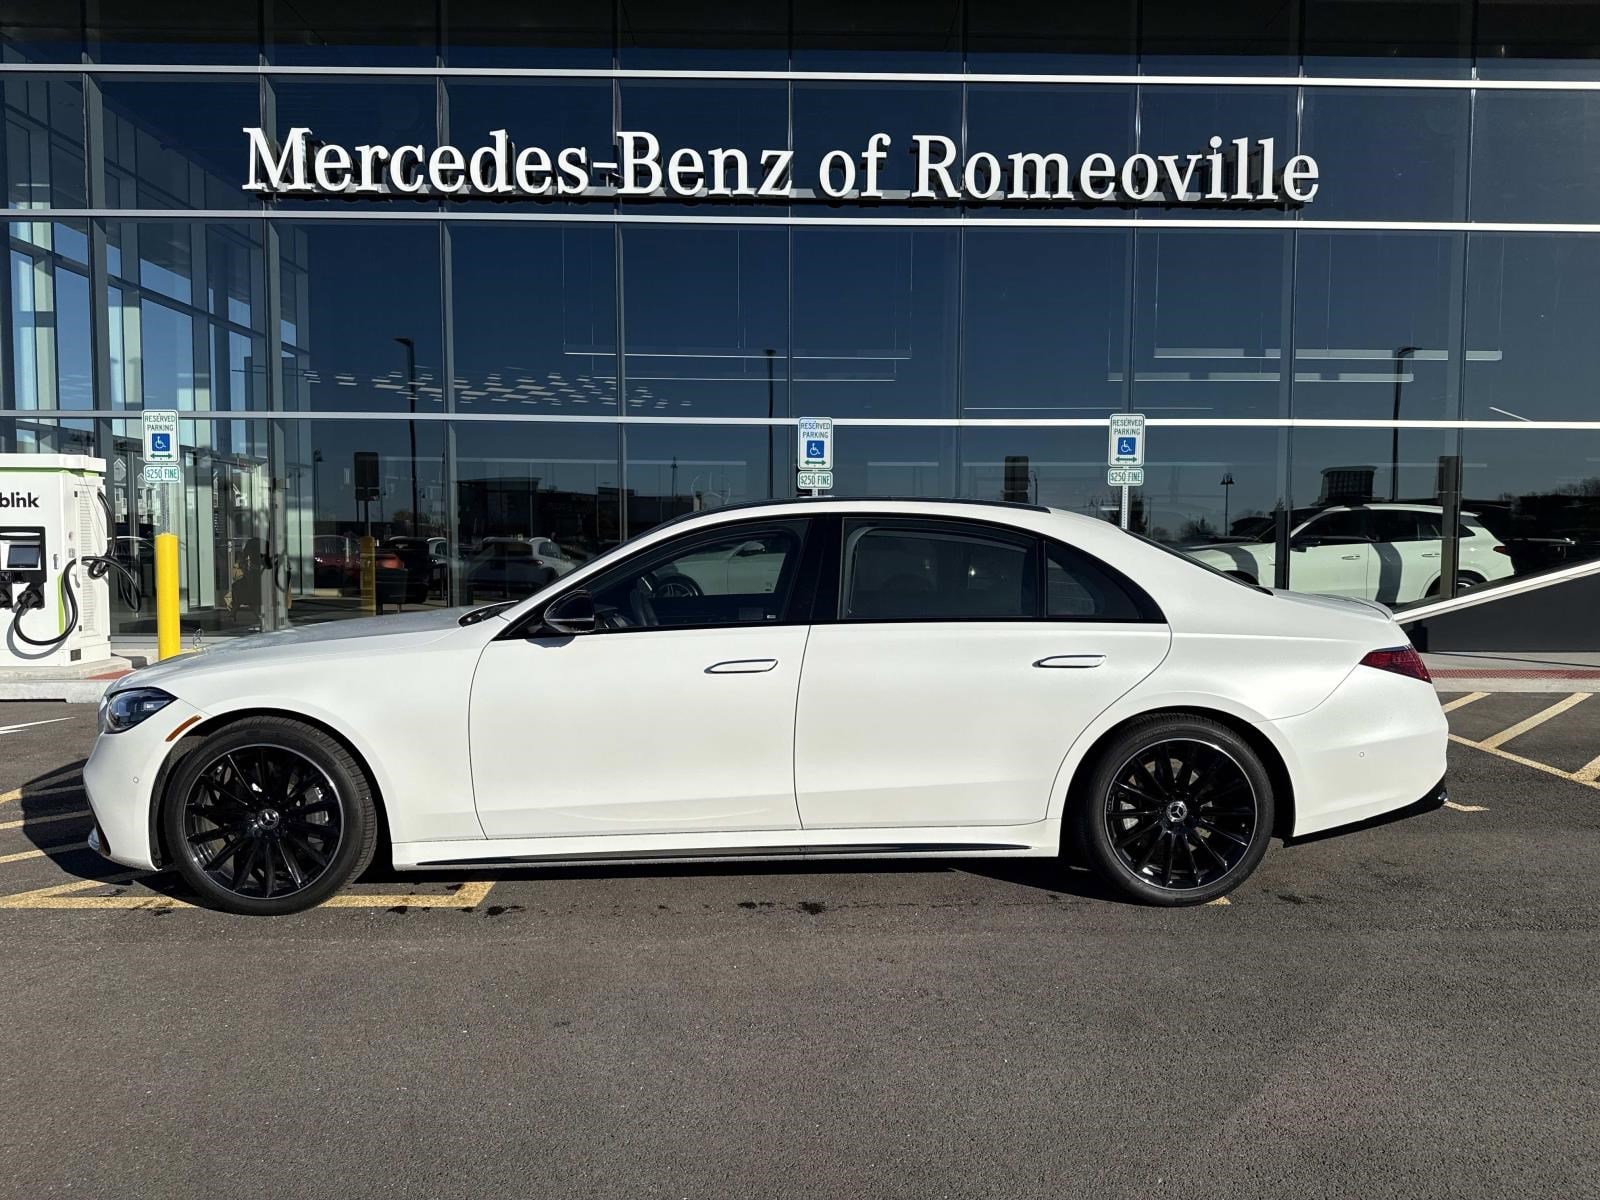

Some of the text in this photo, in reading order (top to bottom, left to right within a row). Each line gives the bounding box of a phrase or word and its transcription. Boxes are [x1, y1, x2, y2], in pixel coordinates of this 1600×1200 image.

[242, 127, 1320, 202] Mercedes-Benz of Romeoville
[144, 415, 175, 423] RESERVED
[1112, 419, 1143, 427] RESERVED
[147, 424, 174, 432] PARKING
[800, 422, 831, 430] RESERVED
[802, 431, 829, 439] PARKING
[1113, 428, 1141, 436] PARKING
[146, 468, 178, 479] $250 FINE
[1110, 471, 1142, 482] $250 FINE
[800, 475, 830, 486] $250 FINE
[0, 491, 39, 508] blink
